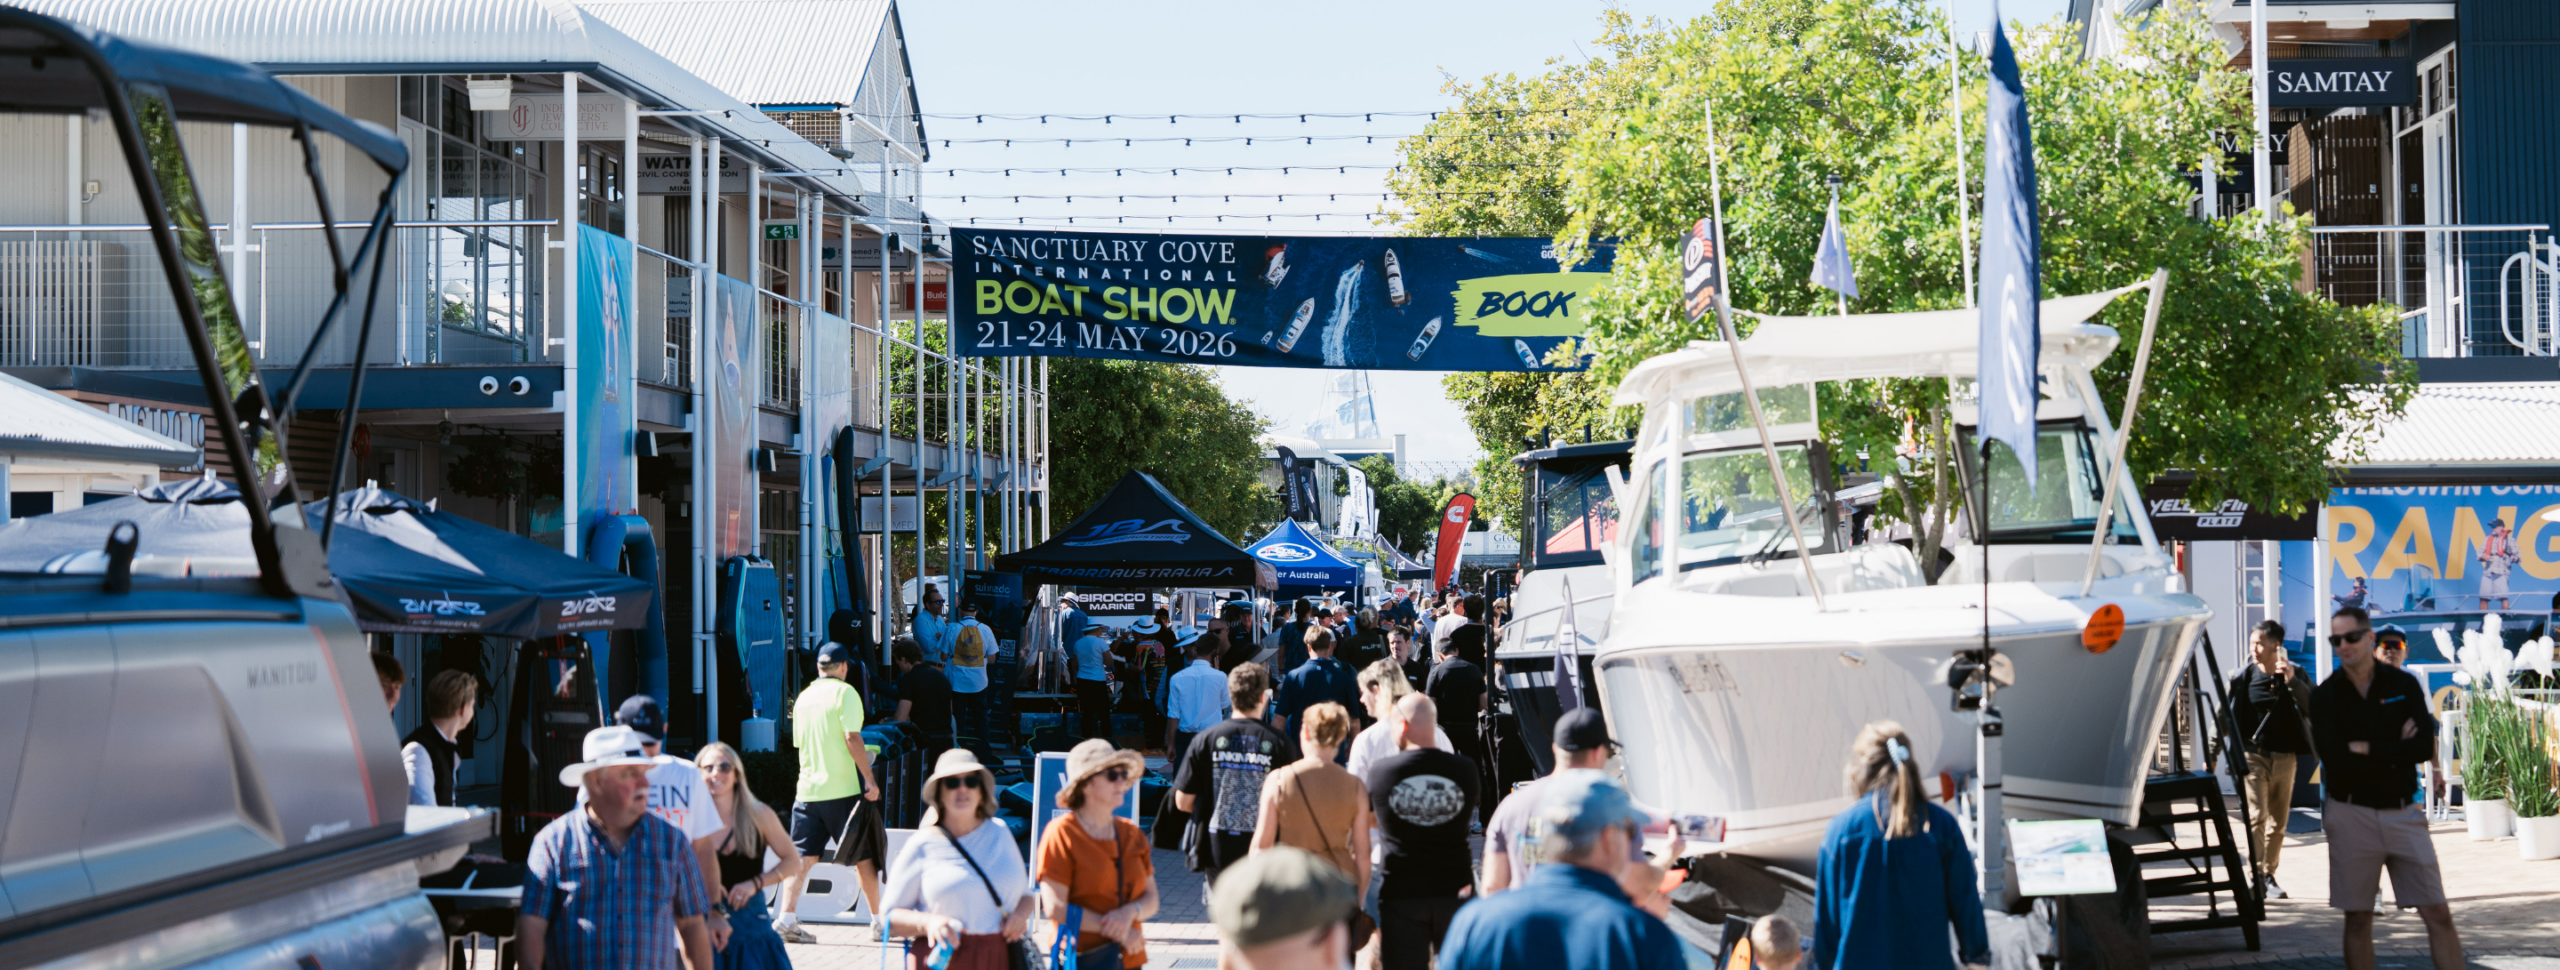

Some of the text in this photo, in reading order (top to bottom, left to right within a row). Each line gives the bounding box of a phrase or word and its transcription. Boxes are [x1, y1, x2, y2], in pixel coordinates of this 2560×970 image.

[2277, 70, 2393, 94] SAMTAY
[540, 103, 616, 113] INDENDENT
[540, 113, 601, 122] JEWLERS
[540, 121, 609, 131] COLCTIVE
[645, 156, 729, 170] WATS
[972, 235, 1236, 264] SANCTUARY COVE
[975, 261, 1236, 283] INTERNATIONAL
[976, 280, 1090, 317] BOAT
[1469, 290, 1577, 321] BOOK
[976, 321, 1237, 357] 21-24 MAY 2026
[864, 521, 915, 530] ELIMED
[2200, 517, 2239, 526] PLATE
[1289, 570, 1330, 579] Australia
[1078, 593, 1146, 603] SIROCCO
[1089, 602, 1135, 611] MARINE
[1212, 751, 1273, 767] LINKIN PARK
